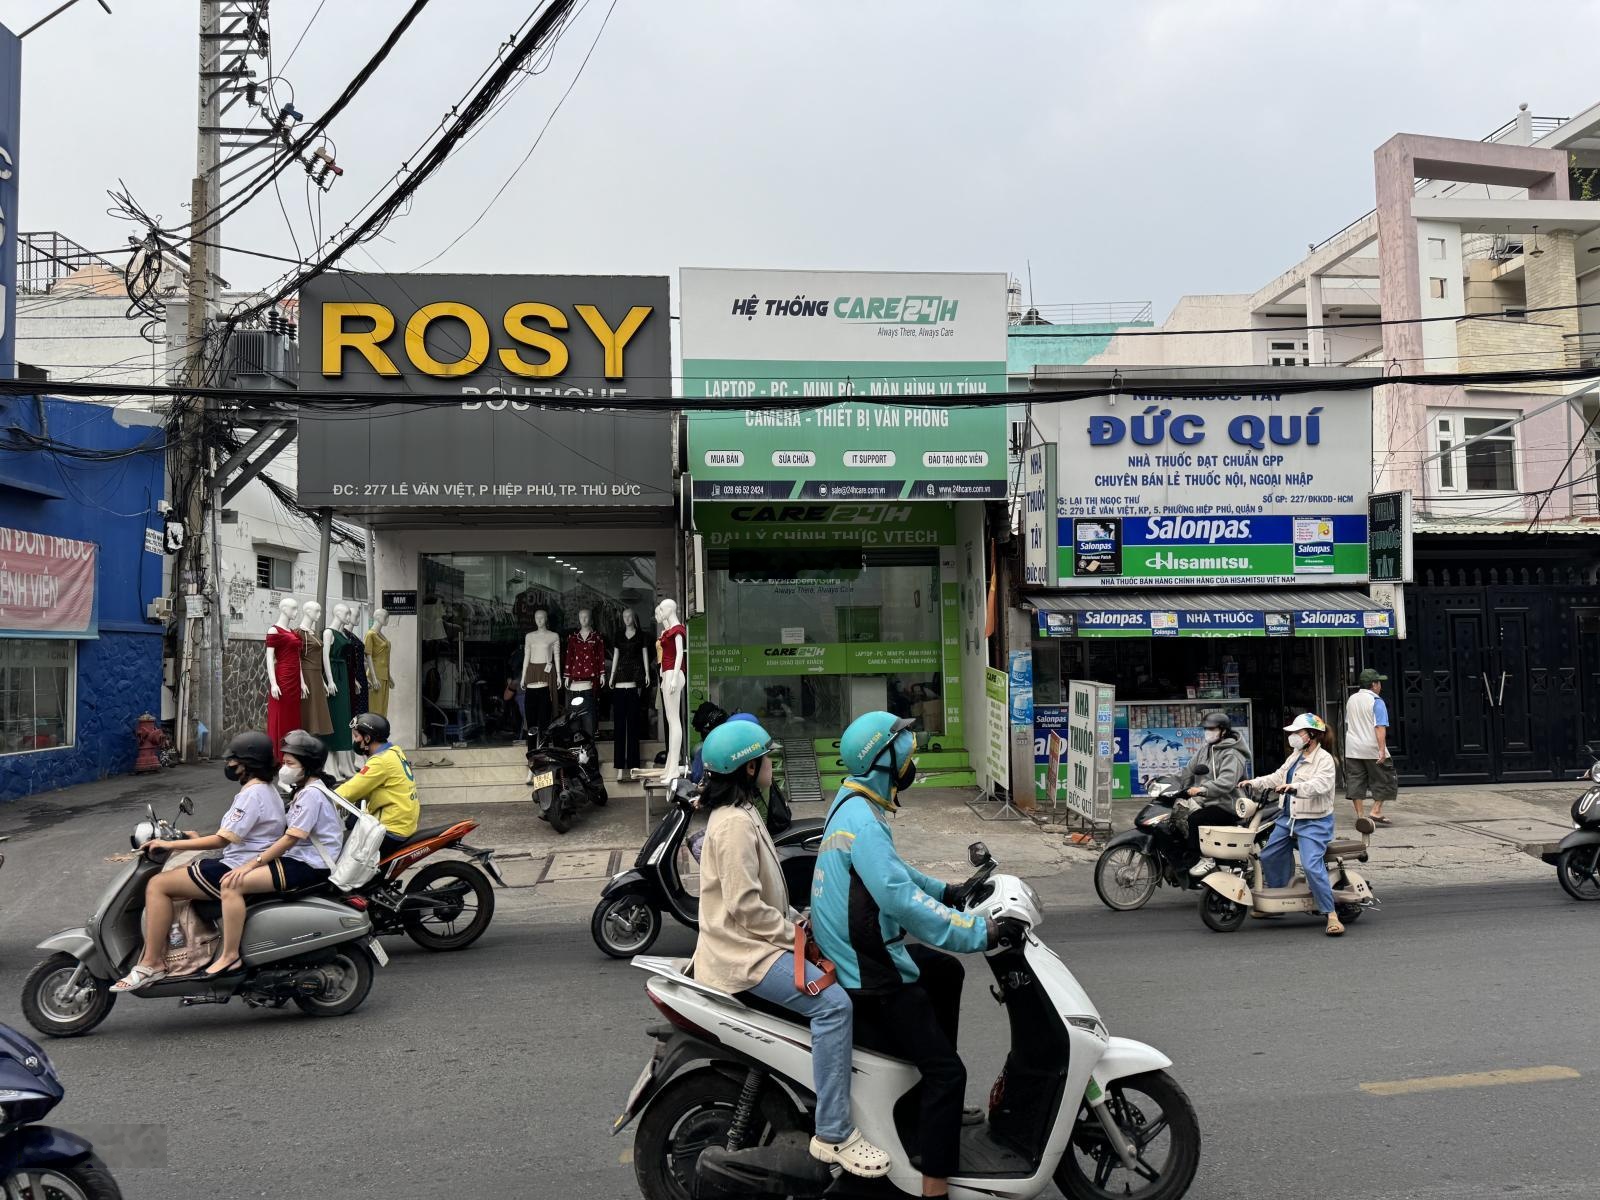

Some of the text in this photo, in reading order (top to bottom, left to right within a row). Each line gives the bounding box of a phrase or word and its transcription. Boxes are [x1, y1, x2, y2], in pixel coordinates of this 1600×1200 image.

[731, 294, 959, 325] HỆ THỐNG CARE24H
[321, 301, 654, 380] ROSY
[877, 327, 954, 338] Always There, Always Care
[705, 378, 987, 397] LAPTOP PC MINI PC MÀN HÌNH VI TÍNH
[744, 401, 949, 431] CAMERA THIẾT BỊ VĂN PHÒNG
[1087, 405, 1325, 450] ĐỨC QUÍ
[710, 453, 739, 464] MUA BÁN
[778, 453, 810, 464] SỬA CHỮA
[852, 454, 887, 464] IT SUPPORT
[928, 453, 983, 466] ĐÀO TẠO HỌC VIÊN
[1030, 448, 1042, 475] NHÀ
[1128, 450, 1284, 469] NHÀ THUỐC ĐẠT CHUẨN GPP
[1094, 470, 1314, 488] CHUYÊN BÁN LẺ THUỐC NỘI, NGOẠI NHẬP
[333, 482, 641, 499] ĐC: 277 LÊ VĂN VIỆT, P HIỆP PHÚ, TP. THỦ ĐỨC
[723, 485, 764, 494] 028 66 52 2424
[1026, 479, 1045, 513] THUỐC
[1262, 493, 1273, 504] SỐ
[1275, 495, 1288, 503] GP:
[1069, 496, 1080, 506] LẠI
[1084, 496, 1098, 506] THỊ
[1100, 496, 1122, 505] NGỌC
[1069, 507, 1085, 515] 279
[1086, 506, 1096, 515] LÊ
[1099, 506, 1114, 515] VĂN
[1117, 506, 1136, 516] VIỆT,
[1138, 506, 1152, 516] KP,
[1153, 506, 1161, 514] 5.
[1163, 504, 1195, 514] PHƯỜNG
[1195, 505, 1213, 515] HIỆP
[1216, 504, 1235, 514] PHÚ,
[1235, 504, 1256, 514] QUẬN
[1257, 505, 1263, 513] 9
[1374, 497, 1395, 521] NHÀ
[730, 504, 913, 524] CARE24H
[883, 530, 938, 543] VTECH
[1030, 522, 1043, 549] TÂY
[1371, 523, 1400, 550] THUỐC
[1080, 541, 1112, 551] Salonpas
[1298, 544, 1331, 554] Salonpas
[1375, 554, 1395, 578] TÂY
[1100, 577, 1115, 586] NHÀ
[1116, 576, 1138, 585] THUỐC
[1139, 576, 1153, 585] BÁN
[1154, 576, 1173, 585] HÀNG
[1174, 576, 1195, 585] CHÍNH
[1215, 575, 1230, 584] CỦA
[1230, 576, 1265, 584] HISAMITSU
[1266, 575, 1280, 583] VIỆT
[31, 565, 59, 619] VIỆN
[1186, 611, 1254, 623] NHÀ THUỐC
[1074, 688, 1090, 718] NHÀ
[1036, 715, 1067, 724] Salonpas
[1070, 722, 1094, 757] THUỐC
[1073, 761, 1088, 792] TÂY
